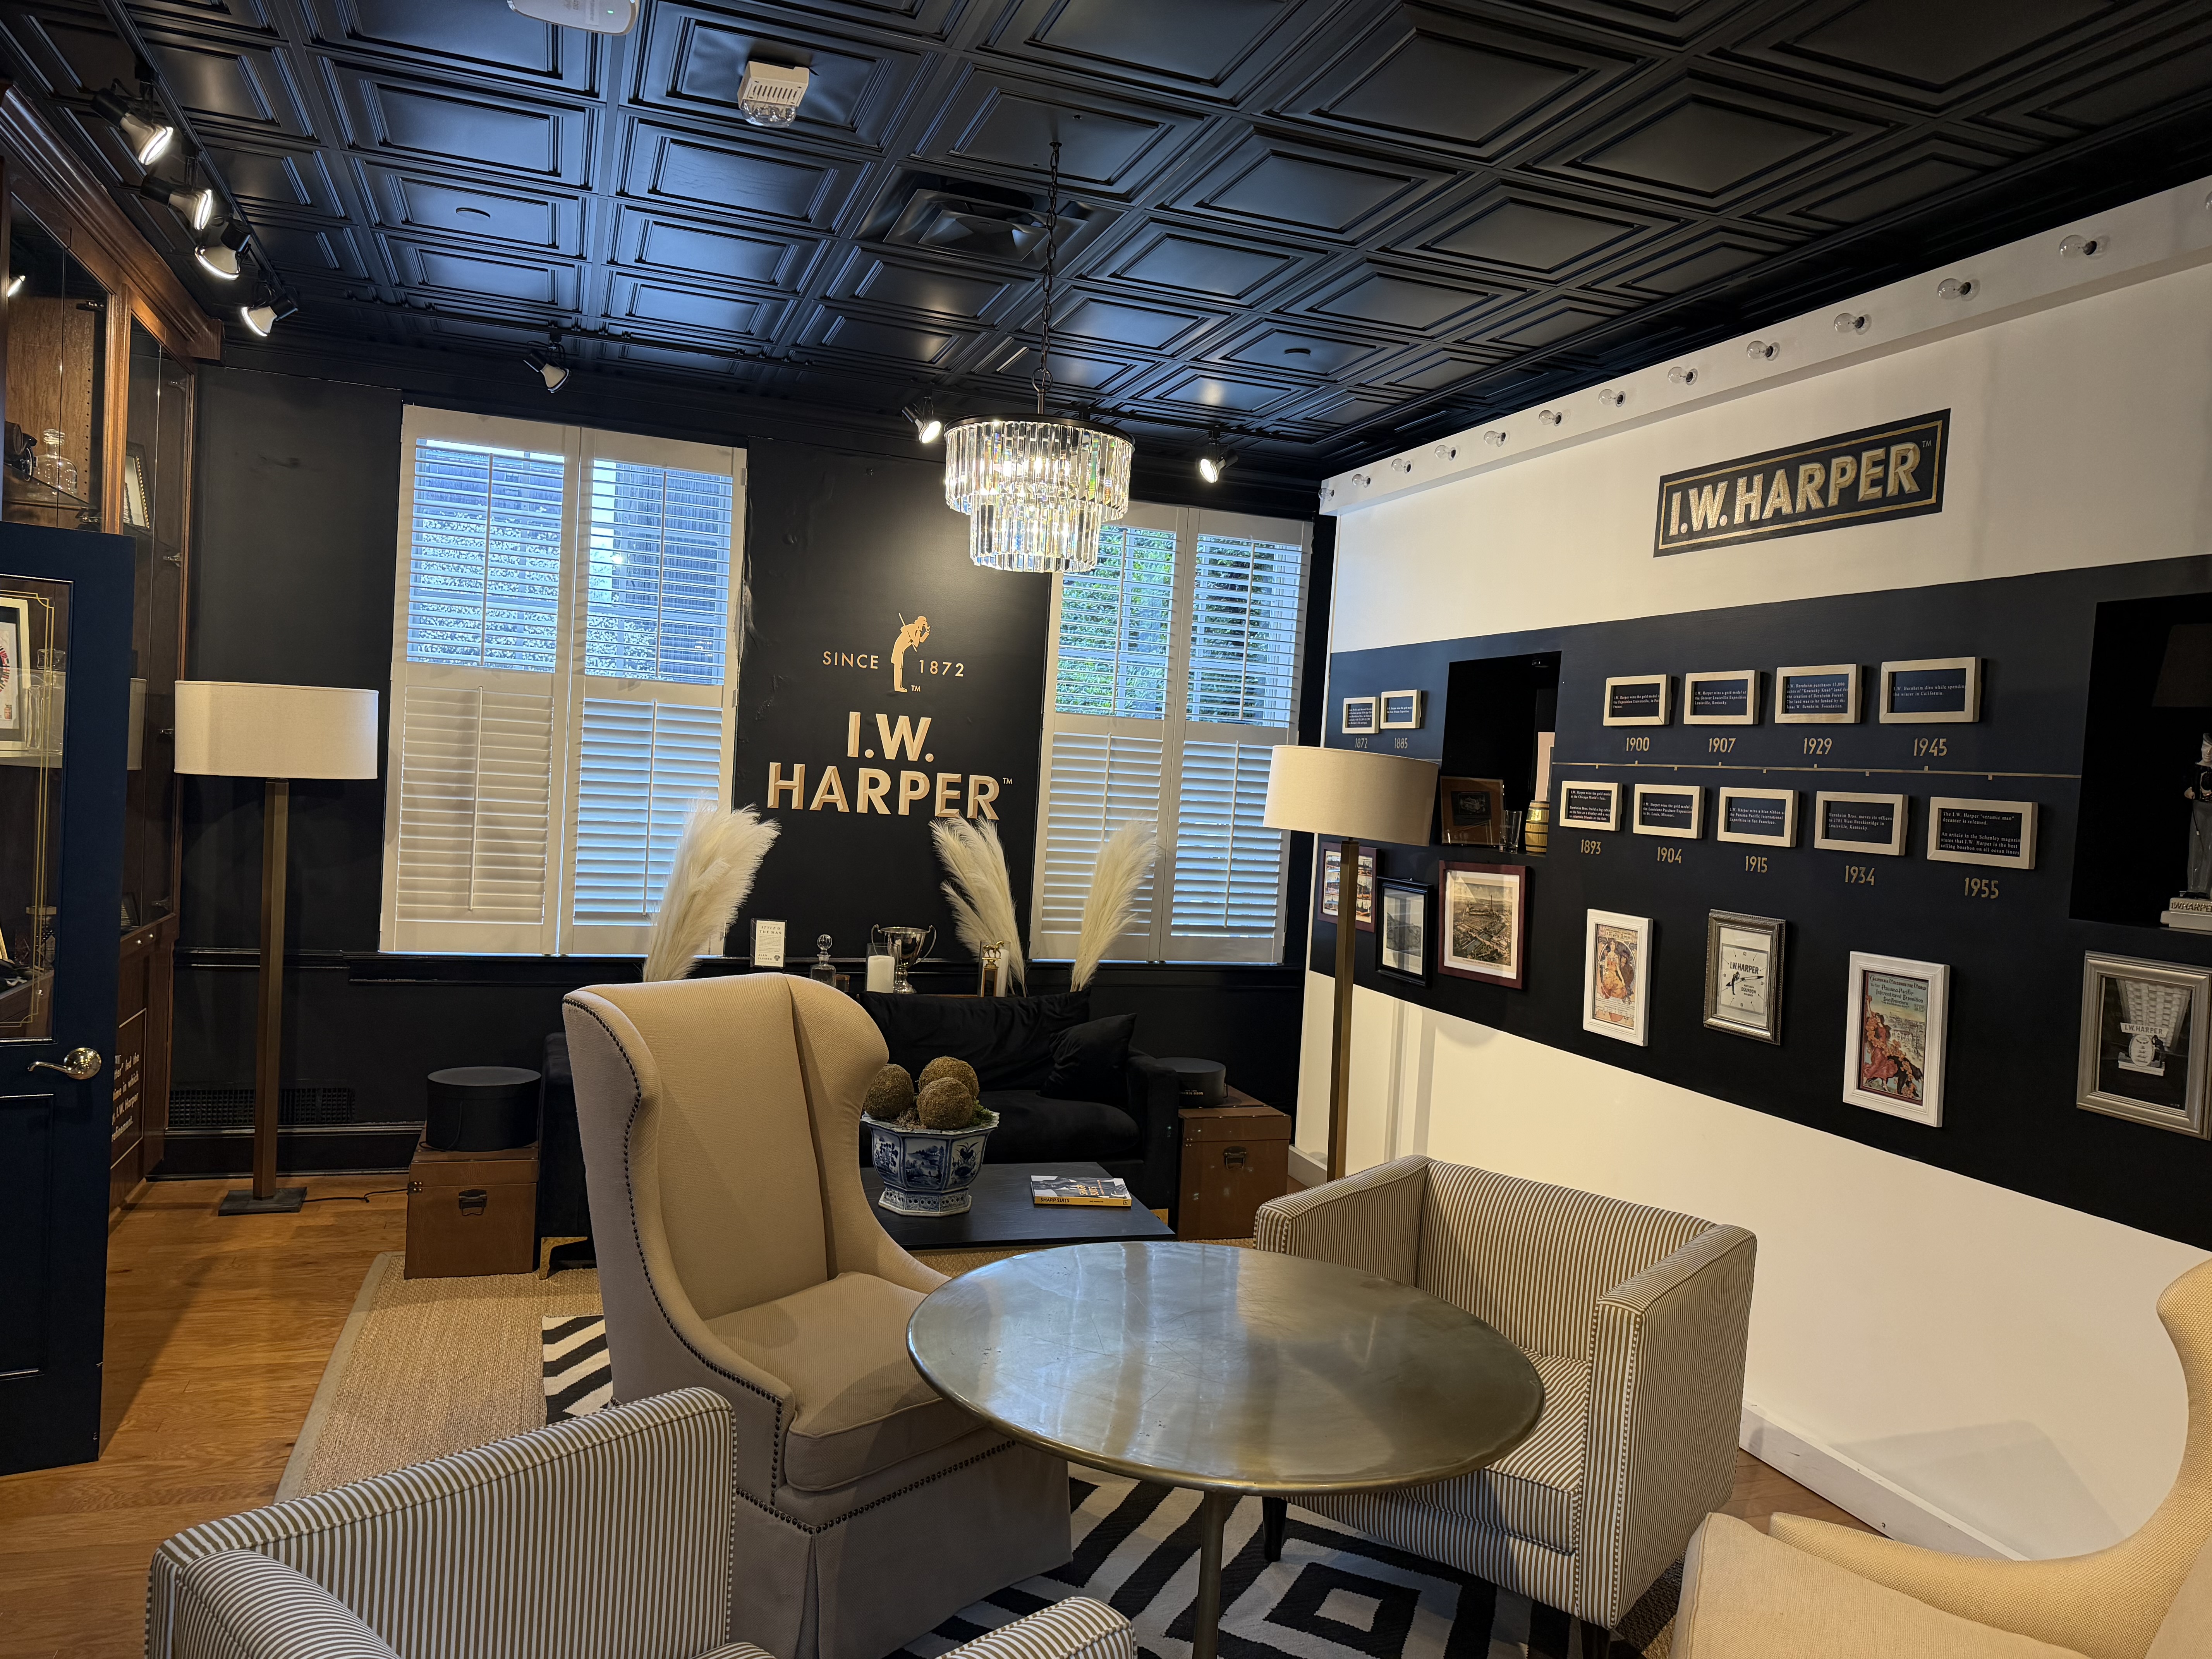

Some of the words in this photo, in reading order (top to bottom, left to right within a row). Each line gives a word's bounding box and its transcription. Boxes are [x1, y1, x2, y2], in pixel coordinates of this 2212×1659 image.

[1668, 480, 1728, 536] I.W.
[1734, 441, 1921, 524] HARPER
[823, 651, 879, 670] SINCE
[919, 659, 964, 677] 1872
[847, 711, 934, 763] I.W.
[1355, 738, 1367, 748] 1872
[1395, 738, 1407, 748] 1885
[1626, 737, 1649, 751] 1900
[1709, 738, 1736, 752] 1907
[1804, 738, 1832, 754] 1929
[1914, 738, 1947, 756] 1945
[766, 762, 1000, 820] HARPER
[1581, 840, 1601, 854] 1893
[1657, 847, 1681, 863] 1904
[1746, 856, 1767, 872] 1915
[1845, 866, 1874, 885] 1934
[1965, 878, 1998, 898] 1955
[1737, 963, 1759, 974] HARPER
[2136, 1025, 2163, 1034] HARPER
[123, 1082, 127, 1093] in
[128, 1070, 139, 1088] which
[125, 1092, 139, 1111] Harper
